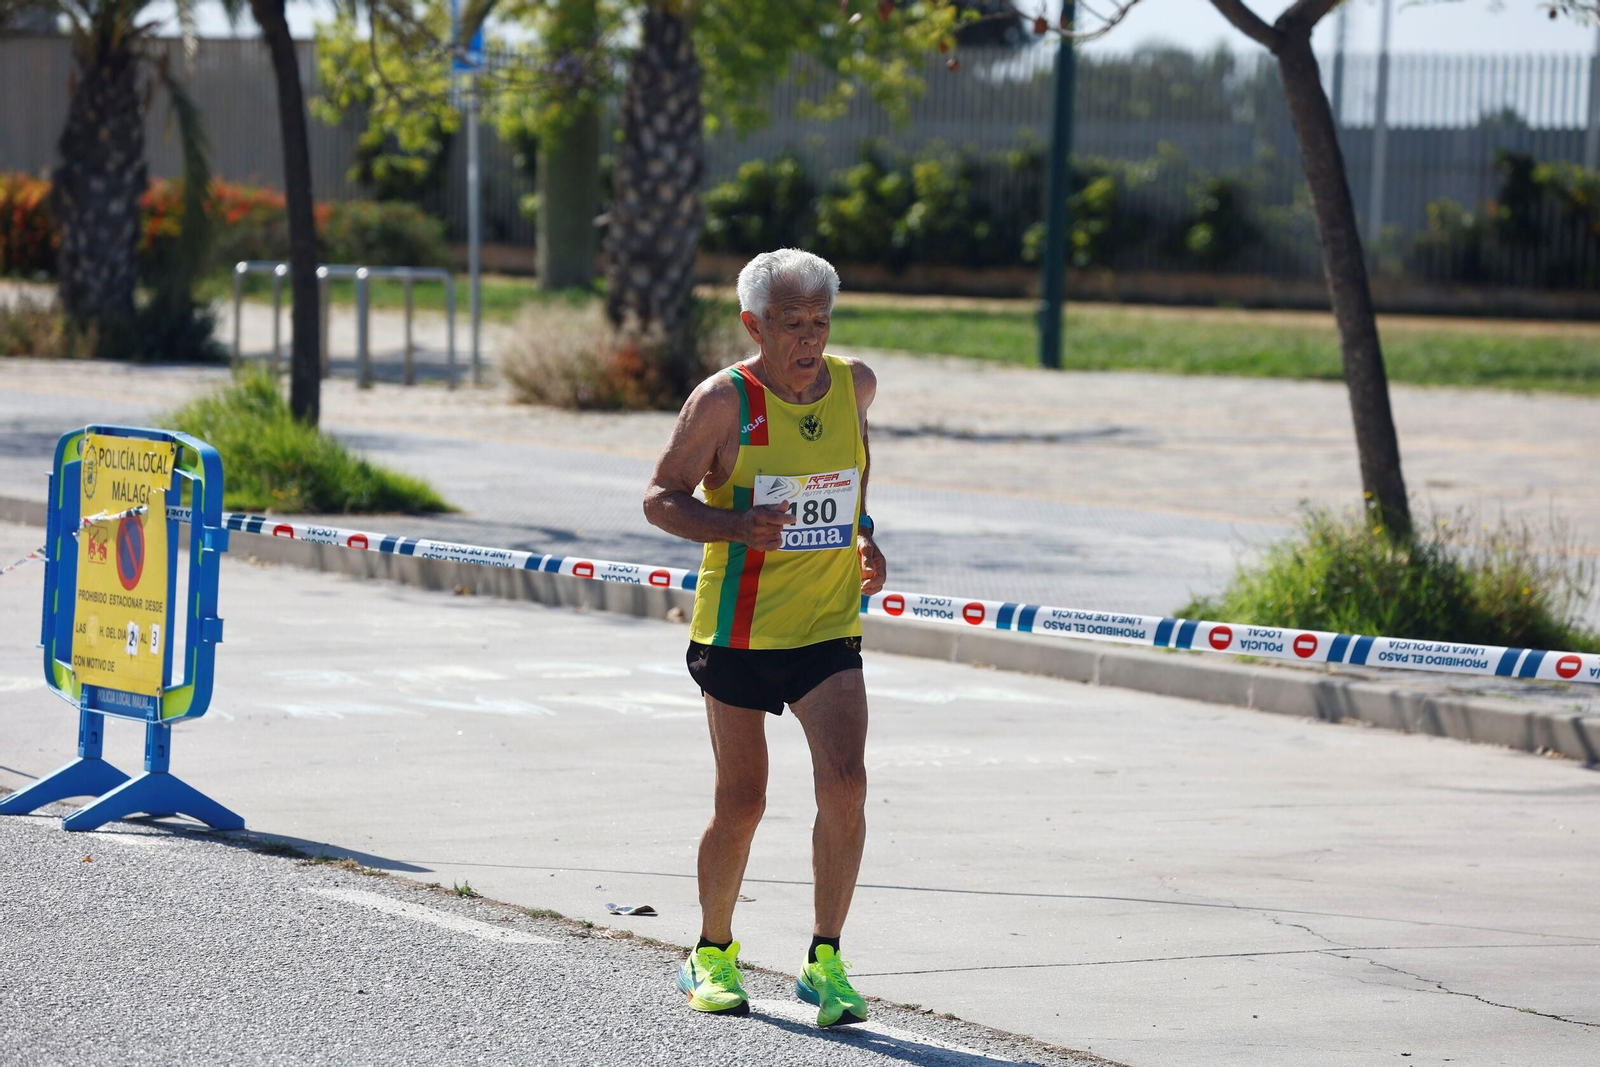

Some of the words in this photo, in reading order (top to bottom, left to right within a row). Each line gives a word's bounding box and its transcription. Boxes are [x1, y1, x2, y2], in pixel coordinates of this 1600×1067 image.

[99, 447, 135, 471] POLICÍA
[138, 452, 168, 474] LOCAL
[786, 498, 837, 526] 180
[307, 527, 338, 538] LOCAL
[607, 563, 640, 574] LOCAL
[79, 589, 107, 604] PROHIBIDO
[109, 594, 143, 609] ESTACIONAR
[145, 599, 163, 613] DESDE
[919, 596, 953, 607] LOCAL
[1052, 609, 1094, 620] POLICÍA
[1094, 613, 1110, 622] DE
[1043, 620, 1071, 631] PASO
[1112, 615, 1142, 626] LÍNEA
[1074, 623, 1085, 632] EL
[1087, 625, 1146, 639] PROHIBIDO
[1247, 628, 1282, 638] LOCAL
[76, 622, 86, 634] LAS
[106, 627, 117, 639] DEL
[140, 633, 148, 644] AL
[152, 631, 158, 647] 3
[1240, 639, 1283, 652] POLICÍA
[1389, 641, 1432, 651] POLICÍA
[1434, 644, 1450, 652] DE
[1378, 652, 1409, 662] PASO
[1452, 646, 1486, 657] LÍNEA
[74, 654, 86, 667] CON
[86, 657, 106, 671] MOTIVO
[107, 660, 115, 672] DE
[1411, 654, 1424, 664] EL
[1425, 655, 1488, 669] PROHIBIDO
